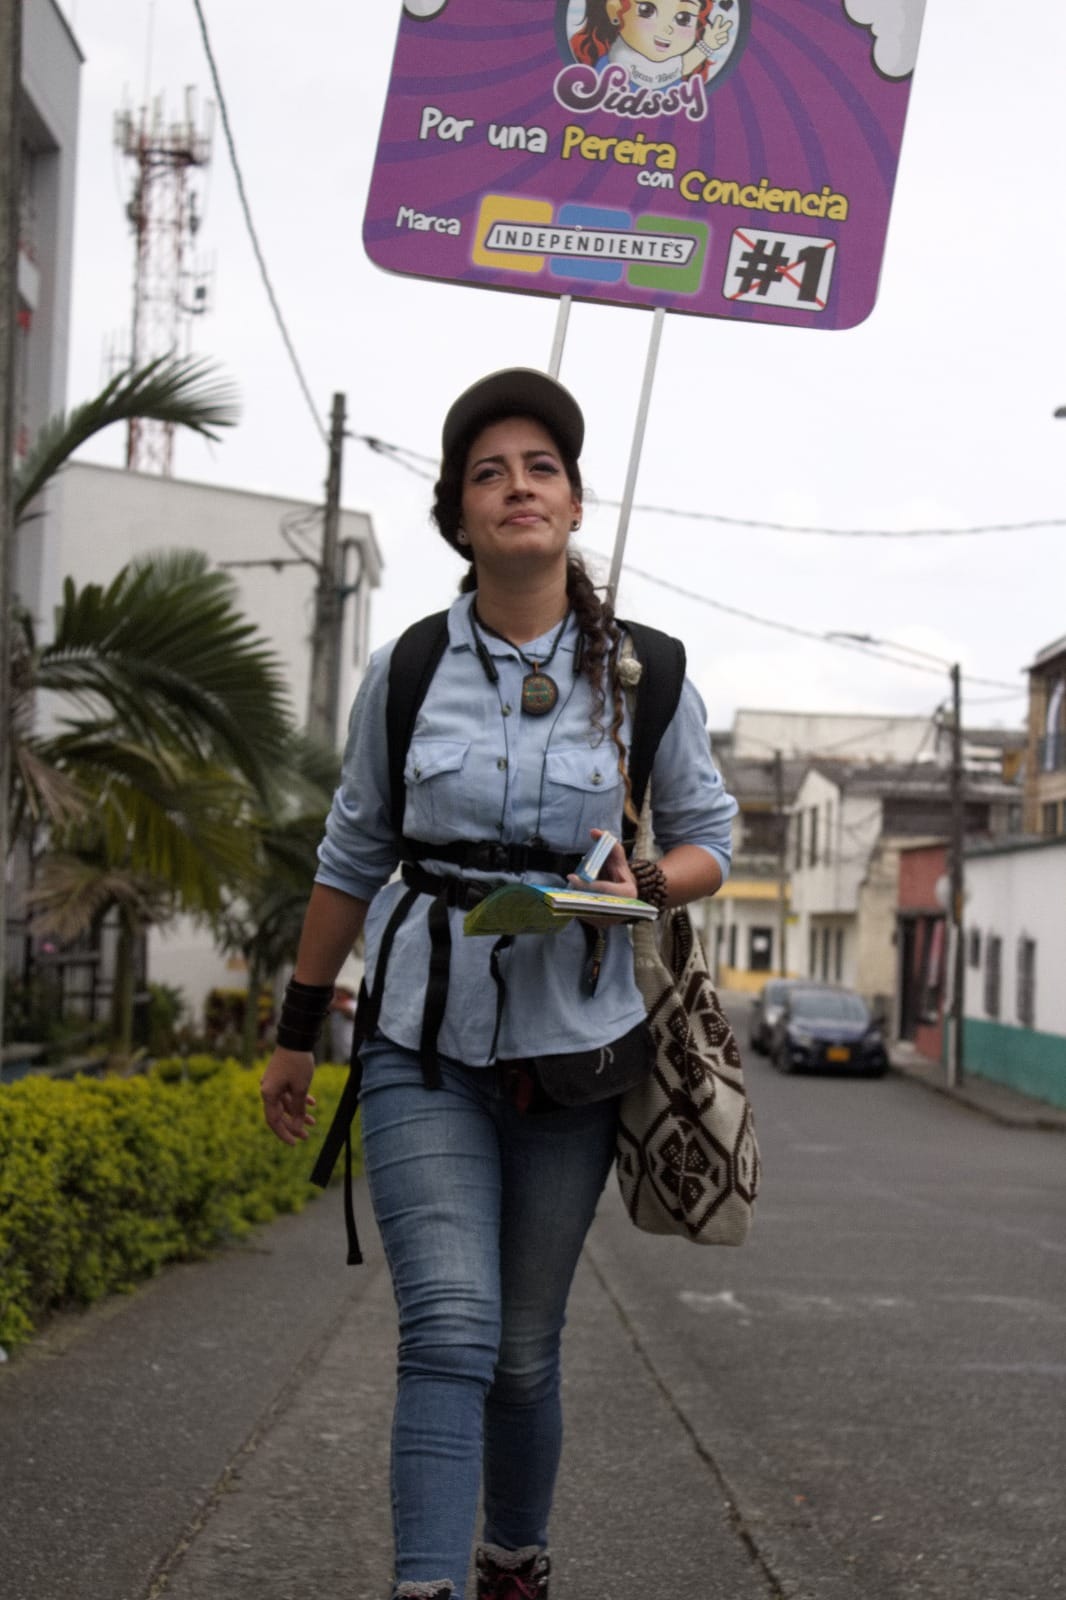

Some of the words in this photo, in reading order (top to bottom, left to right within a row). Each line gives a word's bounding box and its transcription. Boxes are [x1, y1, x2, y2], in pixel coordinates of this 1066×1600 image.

[418, 106, 474, 143] Por
[487, 123, 548, 154] una
[560, 124, 678, 171] Pereira
[396, 206, 461, 236] Marca
[636, 170, 675, 189] con
[679, 169, 850, 222] Conciencia
[495, 229, 684, 259] INDEPENDIENTES
[734, 238, 827, 303] #1
